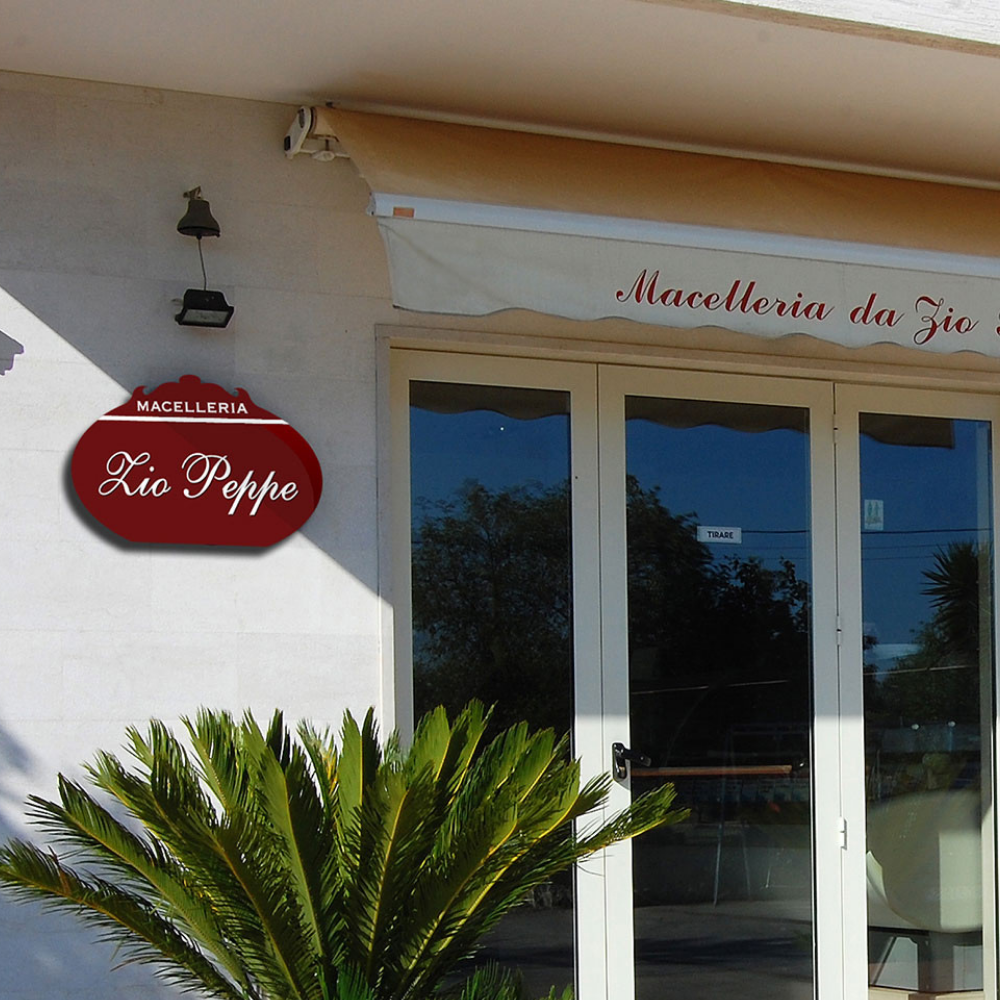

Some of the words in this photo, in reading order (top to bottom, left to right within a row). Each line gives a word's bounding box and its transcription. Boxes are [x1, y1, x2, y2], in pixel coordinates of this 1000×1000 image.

[616, 269, 835, 321] Macelleria
[850, 293, 904, 327] da
[913, 295, 979, 345] Zio
[137, 401, 248, 414] MACELLERIA
[98, 451, 171, 497] Zio
[182, 453, 298, 516] Peppe
[707, 530, 734, 539] TIRARE
